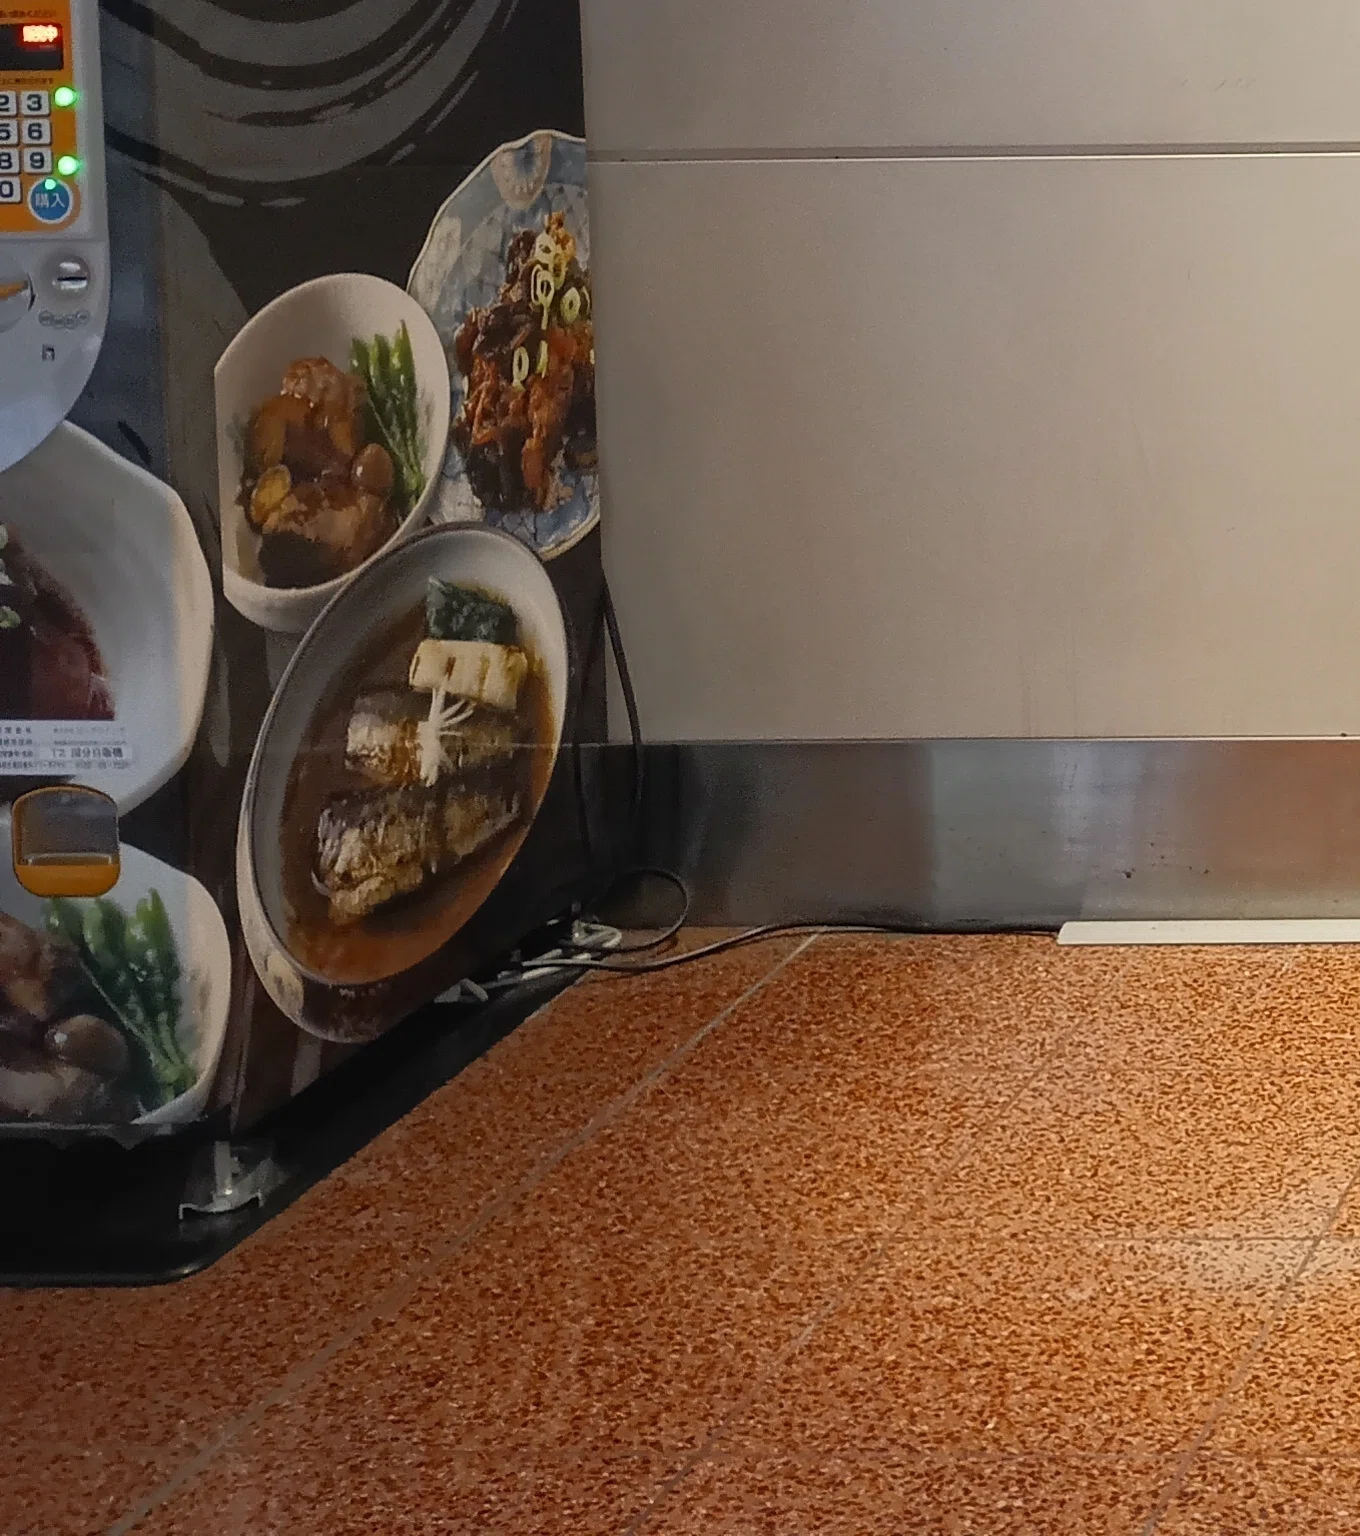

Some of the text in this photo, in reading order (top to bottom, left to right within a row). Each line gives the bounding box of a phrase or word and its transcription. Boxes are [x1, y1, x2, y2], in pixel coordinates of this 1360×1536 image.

[27, 94, 42, 111] 3
[28, 123, 43, 140] 6
[29, 151, 45, 169] 9
[35, 192, 65, 209] 購入
